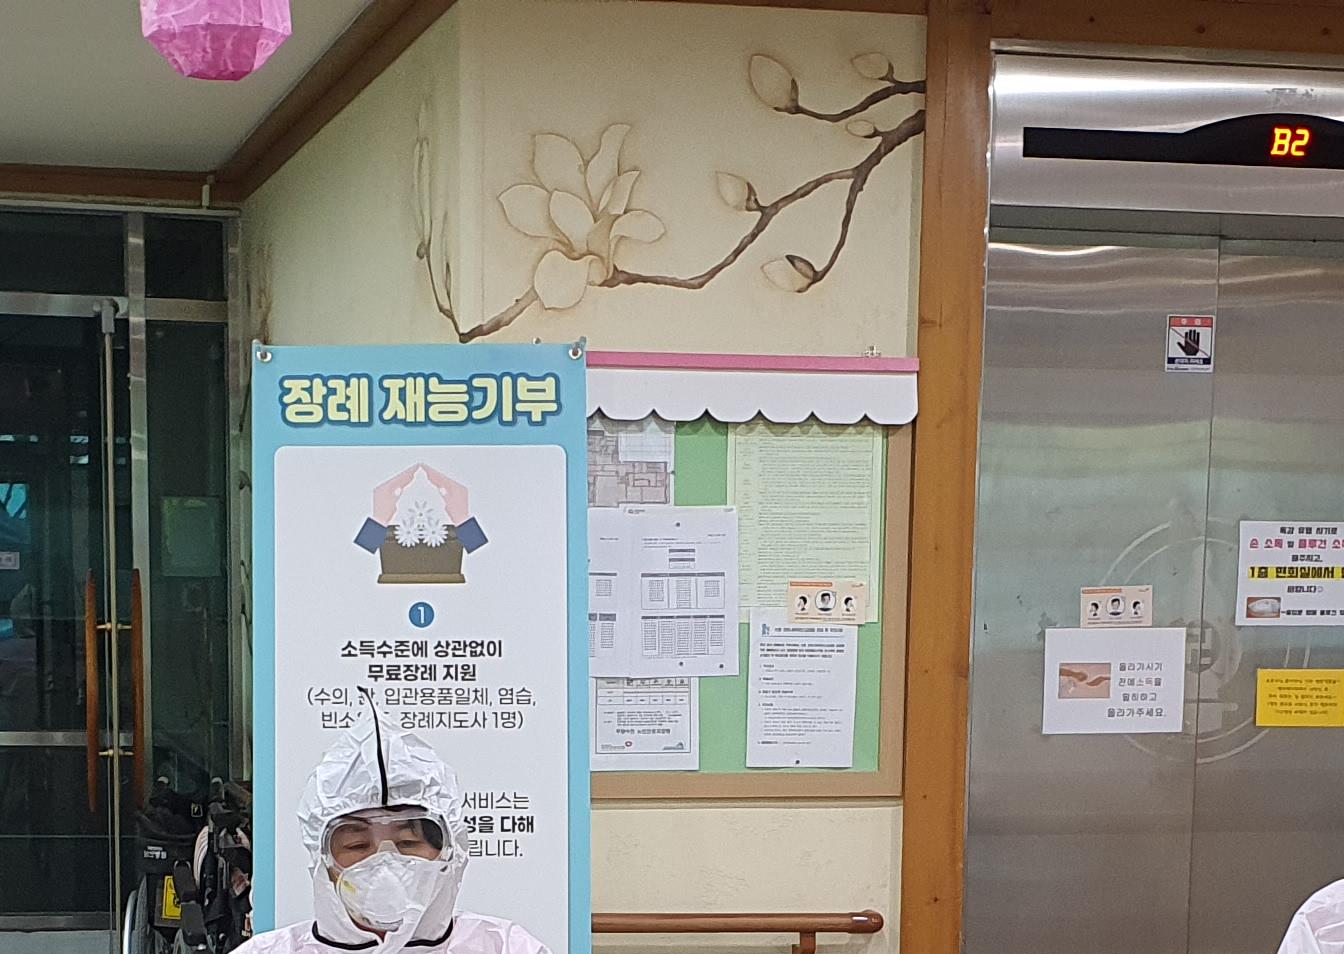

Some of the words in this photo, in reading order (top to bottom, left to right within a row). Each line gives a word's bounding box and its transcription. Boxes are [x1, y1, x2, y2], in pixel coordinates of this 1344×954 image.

[1270, 126, 1311, 157] B2
[281, 375, 370, 425] 장례
[380, 374, 559, 425] 재능기부
[1249, 538, 1259, 549] 손
[340, 640, 429, 658] 소득수준에
[433, 640, 503, 658] 상관없이
[367, 664, 437, 682] 무료장례
[442, 664, 477, 682] 지원
[307, 687, 353, 708] (수의,
[385, 688, 493, 707] 입관용품일체,
[498, 687, 537, 707] 염습,
[400, 711, 488, 730] 장례지도사
[493, 711, 524, 730] 1명)
[461, 791, 529, 810] 서비스는
[500, 815, 534, 833] 다해
